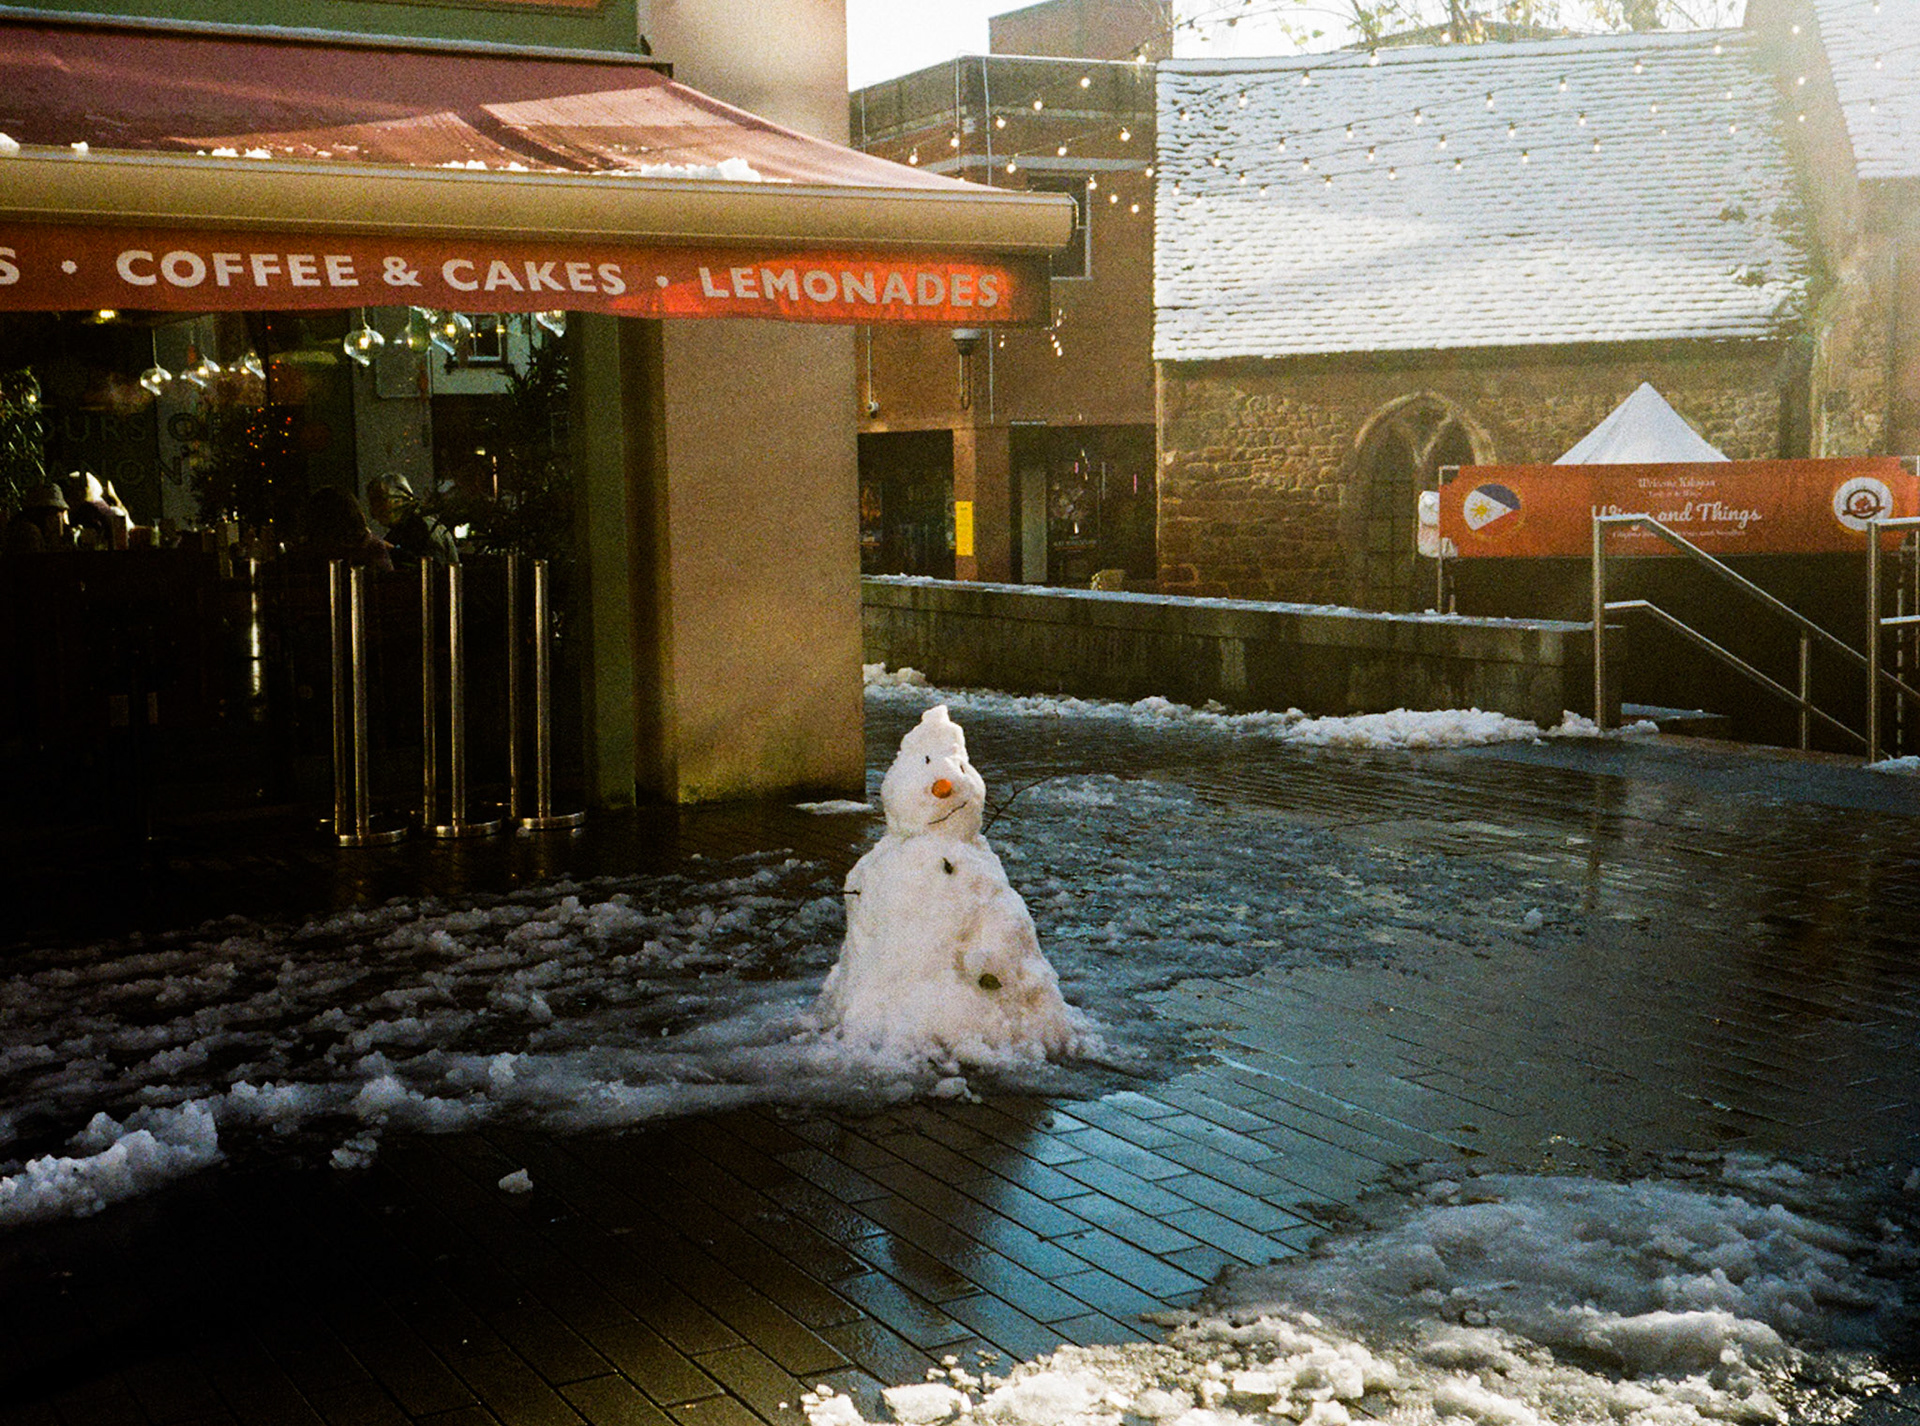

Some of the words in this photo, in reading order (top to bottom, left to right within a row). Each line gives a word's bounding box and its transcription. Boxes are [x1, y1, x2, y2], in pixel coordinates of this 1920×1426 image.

[115, 249, 359, 288] COFFEE
[382, 256, 420, 287] &
[441, 257, 627, 296] CAKES
[699, 266, 999, 307] LEMONADES
[1658, 501, 1694, 521] and
[1696, 501, 1763, 529] Things
